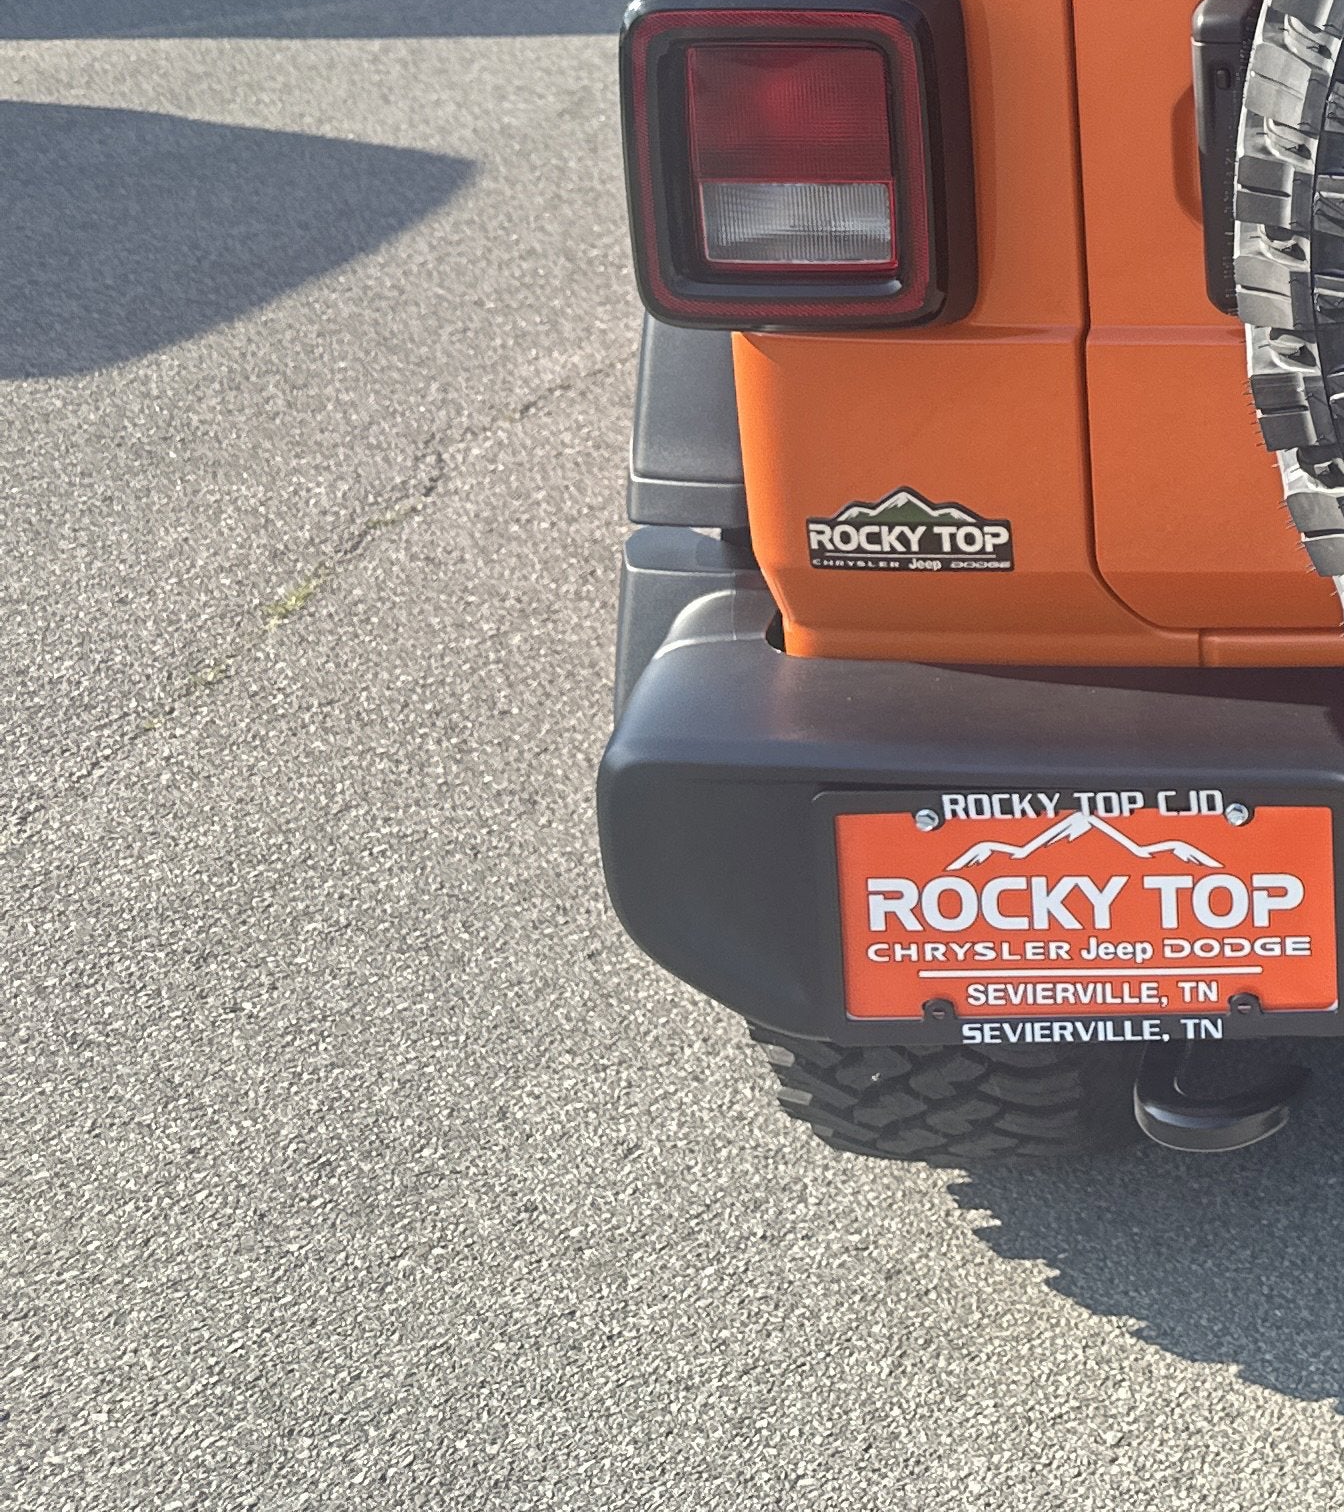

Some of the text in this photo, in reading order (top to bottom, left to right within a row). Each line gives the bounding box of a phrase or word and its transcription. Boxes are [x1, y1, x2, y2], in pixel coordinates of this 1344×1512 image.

[808, 523, 1010, 553] ROCKY TOP
[908, 557, 942, 571] Jeep
[941, 789, 1224, 821] ROCKY TOP CJD
[866, 872, 1306, 932] ROCKY TOP
[867, 935, 1312, 964] CHRYSLER Jeep DODGE
[966, 980, 1219, 1007] SEVIERVILLE, TN
[961, 1018, 1224, 1044] SEVIERVILLE, TN
